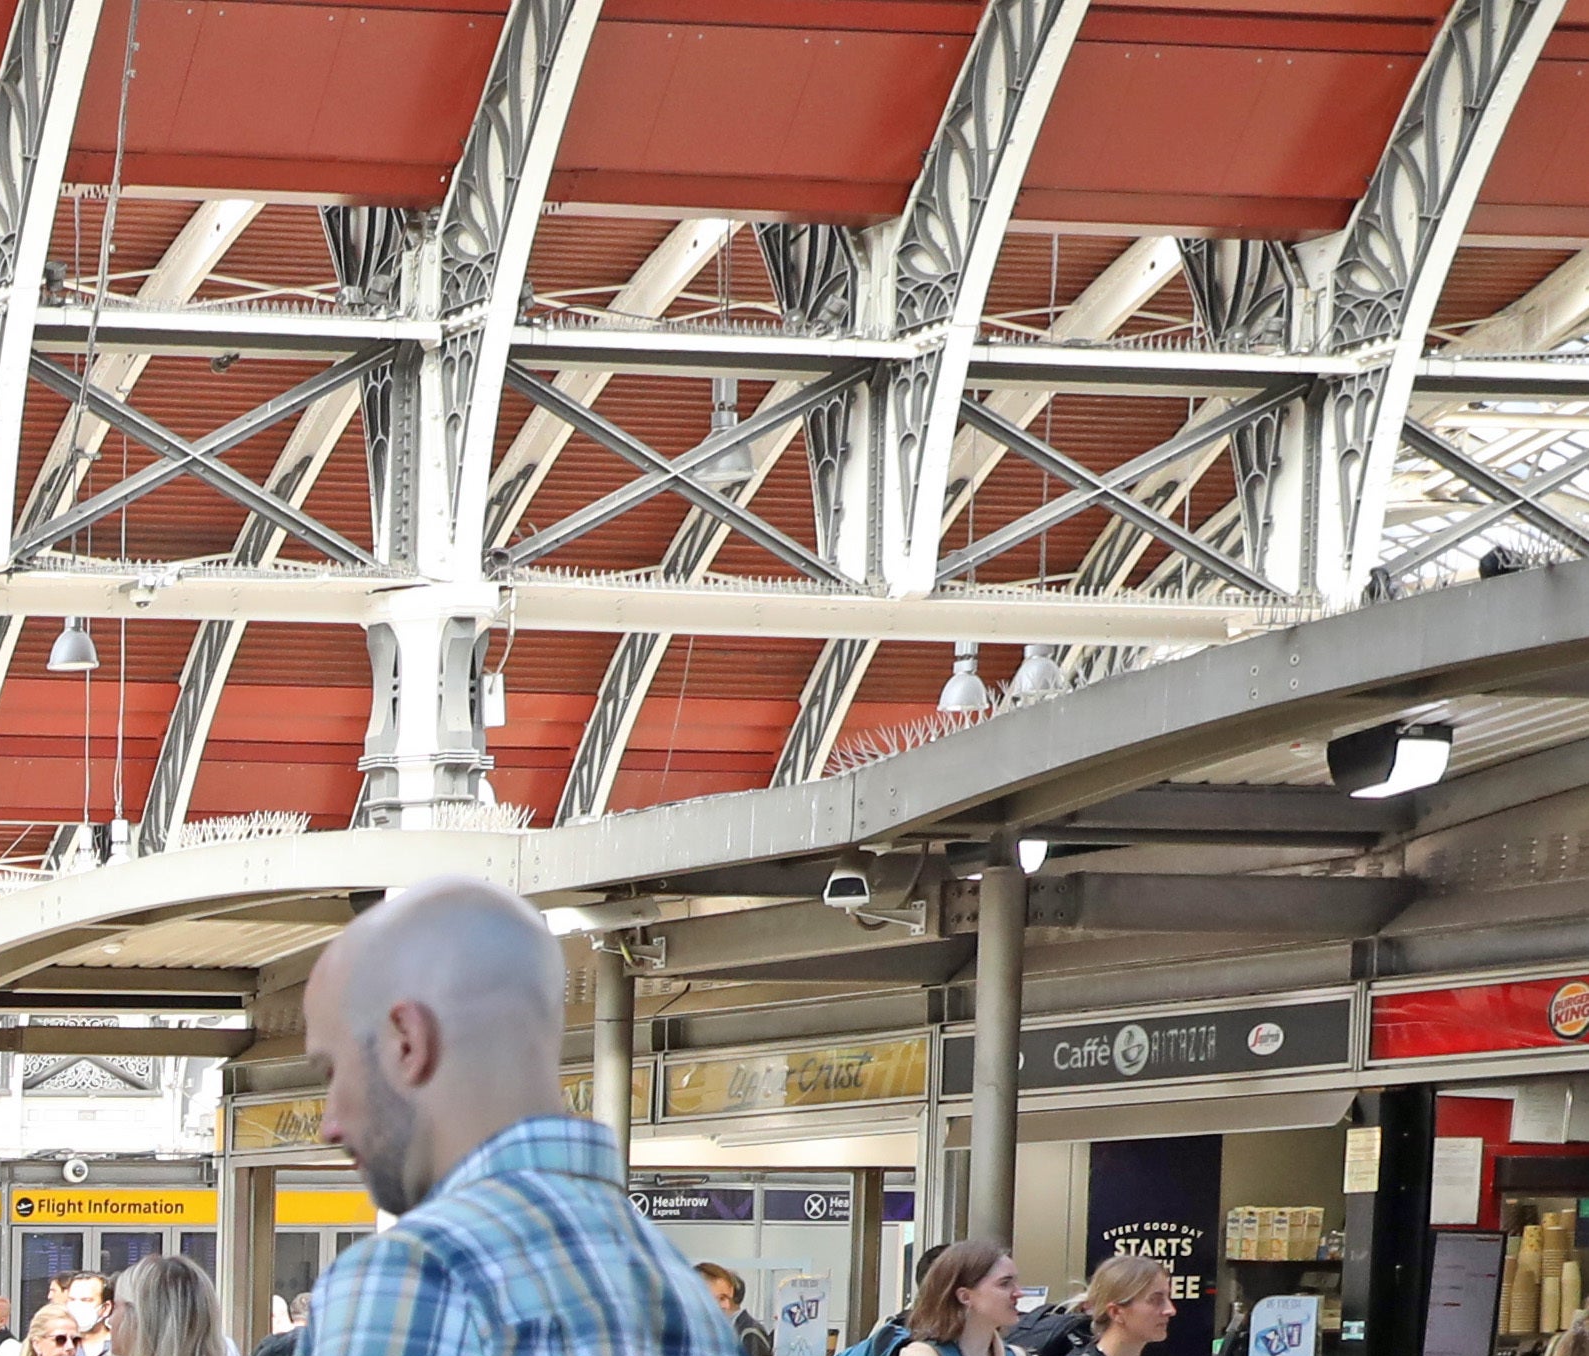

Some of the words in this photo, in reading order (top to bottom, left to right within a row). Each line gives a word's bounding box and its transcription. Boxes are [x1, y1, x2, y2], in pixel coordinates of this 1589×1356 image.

[1053, 1036, 1111, 1070] Caffè
[37, 1198, 83, 1217] Flight
[88, 1198, 184, 1214] Information
[652, 1195, 709, 1209] Heathrow
[652, 1208, 681, 1217] Express
[1102, 1222, 1139, 1241] EVERY
[1143, 1222, 1177, 1232] GOOD
[1181, 1225, 1204, 1239] DAY
[1113, 1237, 1193, 1257] STARTS
